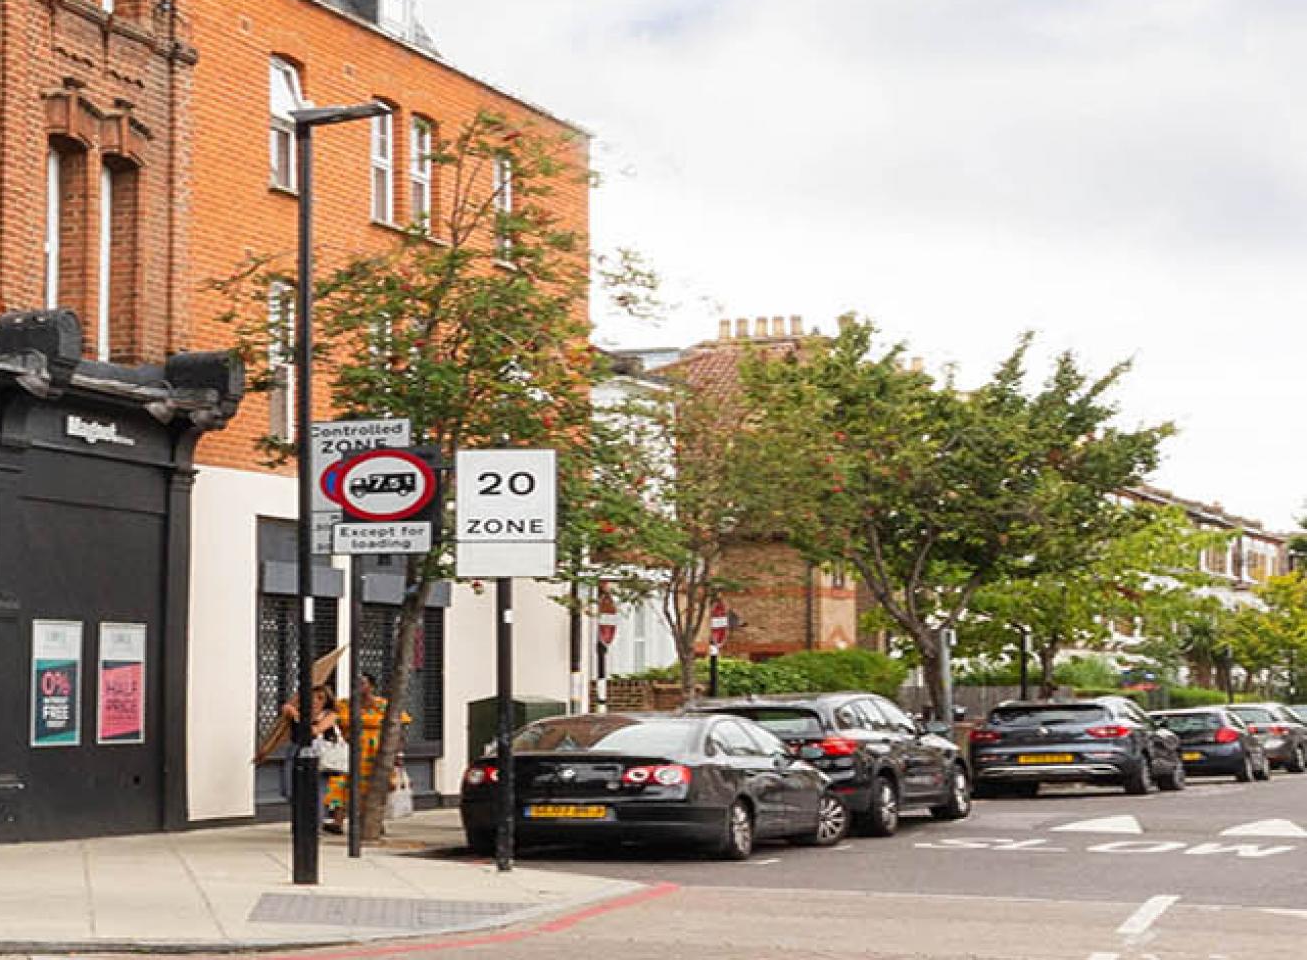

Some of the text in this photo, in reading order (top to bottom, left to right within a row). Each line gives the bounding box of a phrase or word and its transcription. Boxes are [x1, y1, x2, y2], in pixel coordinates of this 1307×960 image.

[311, 423, 404, 439] Controlled
[322, 439, 387, 455] ZONE
[477, 471, 536, 496] 20
[340, 525, 425, 539] Except for
[466, 518, 545, 535] ZONE
[351, 539, 412, 551] loading
[40, 671, 72, 697] 0%
[42, 704, 70, 721] FREE
